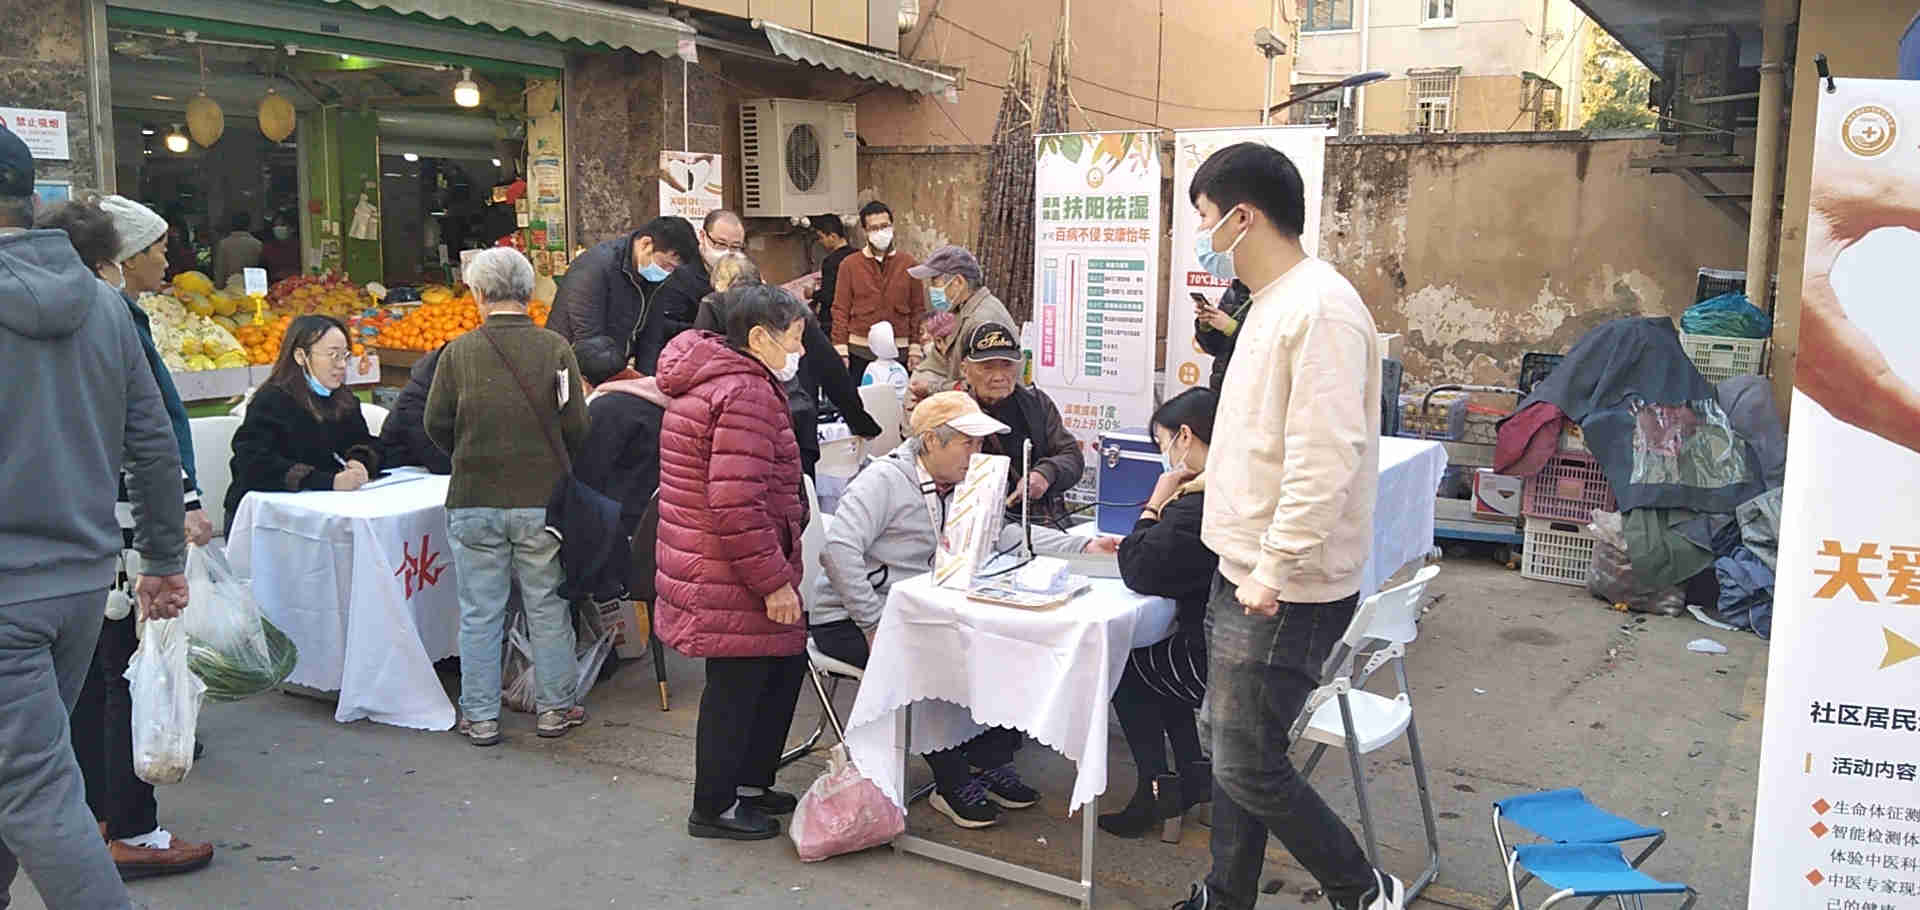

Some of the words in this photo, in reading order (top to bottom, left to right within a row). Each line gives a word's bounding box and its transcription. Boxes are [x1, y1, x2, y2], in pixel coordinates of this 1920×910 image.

[1063, 195, 1149, 220] 扶阳祛湿
[1810, 701, 1920, 732] 社区居民
[1832, 756, 1917, 781] 活动内容
[1832, 800, 1920, 823] 生命体征测
[1832, 824, 1920, 847] 智能检测体
[1830, 848, 1920, 873] 体验中医科
[1828, 873, 1920, 897] 中医专家现
